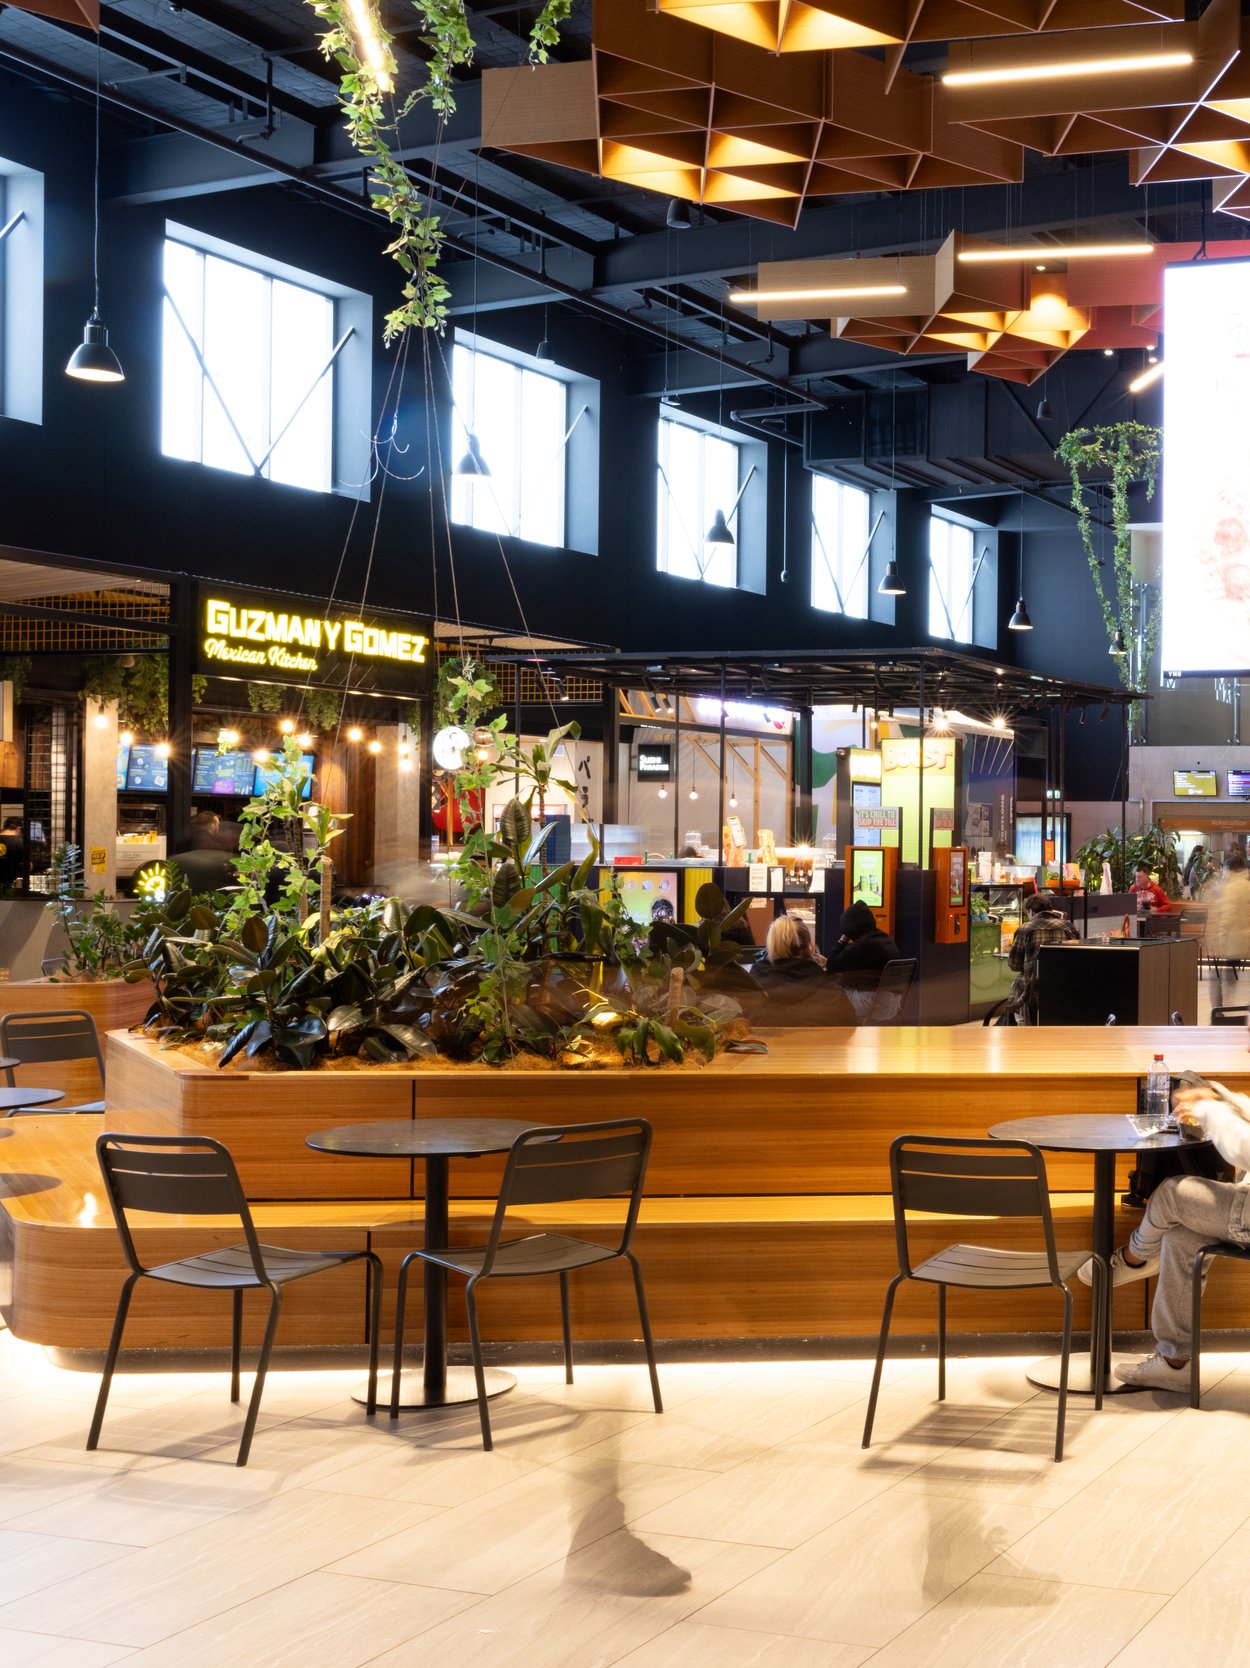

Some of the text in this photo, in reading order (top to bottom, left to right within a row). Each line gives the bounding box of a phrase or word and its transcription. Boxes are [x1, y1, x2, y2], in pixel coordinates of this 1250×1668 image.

[204, 638, 318, 671] Mexican Kitchen
[207, 599, 426, 663] GUZMAN Y GOMEZ
